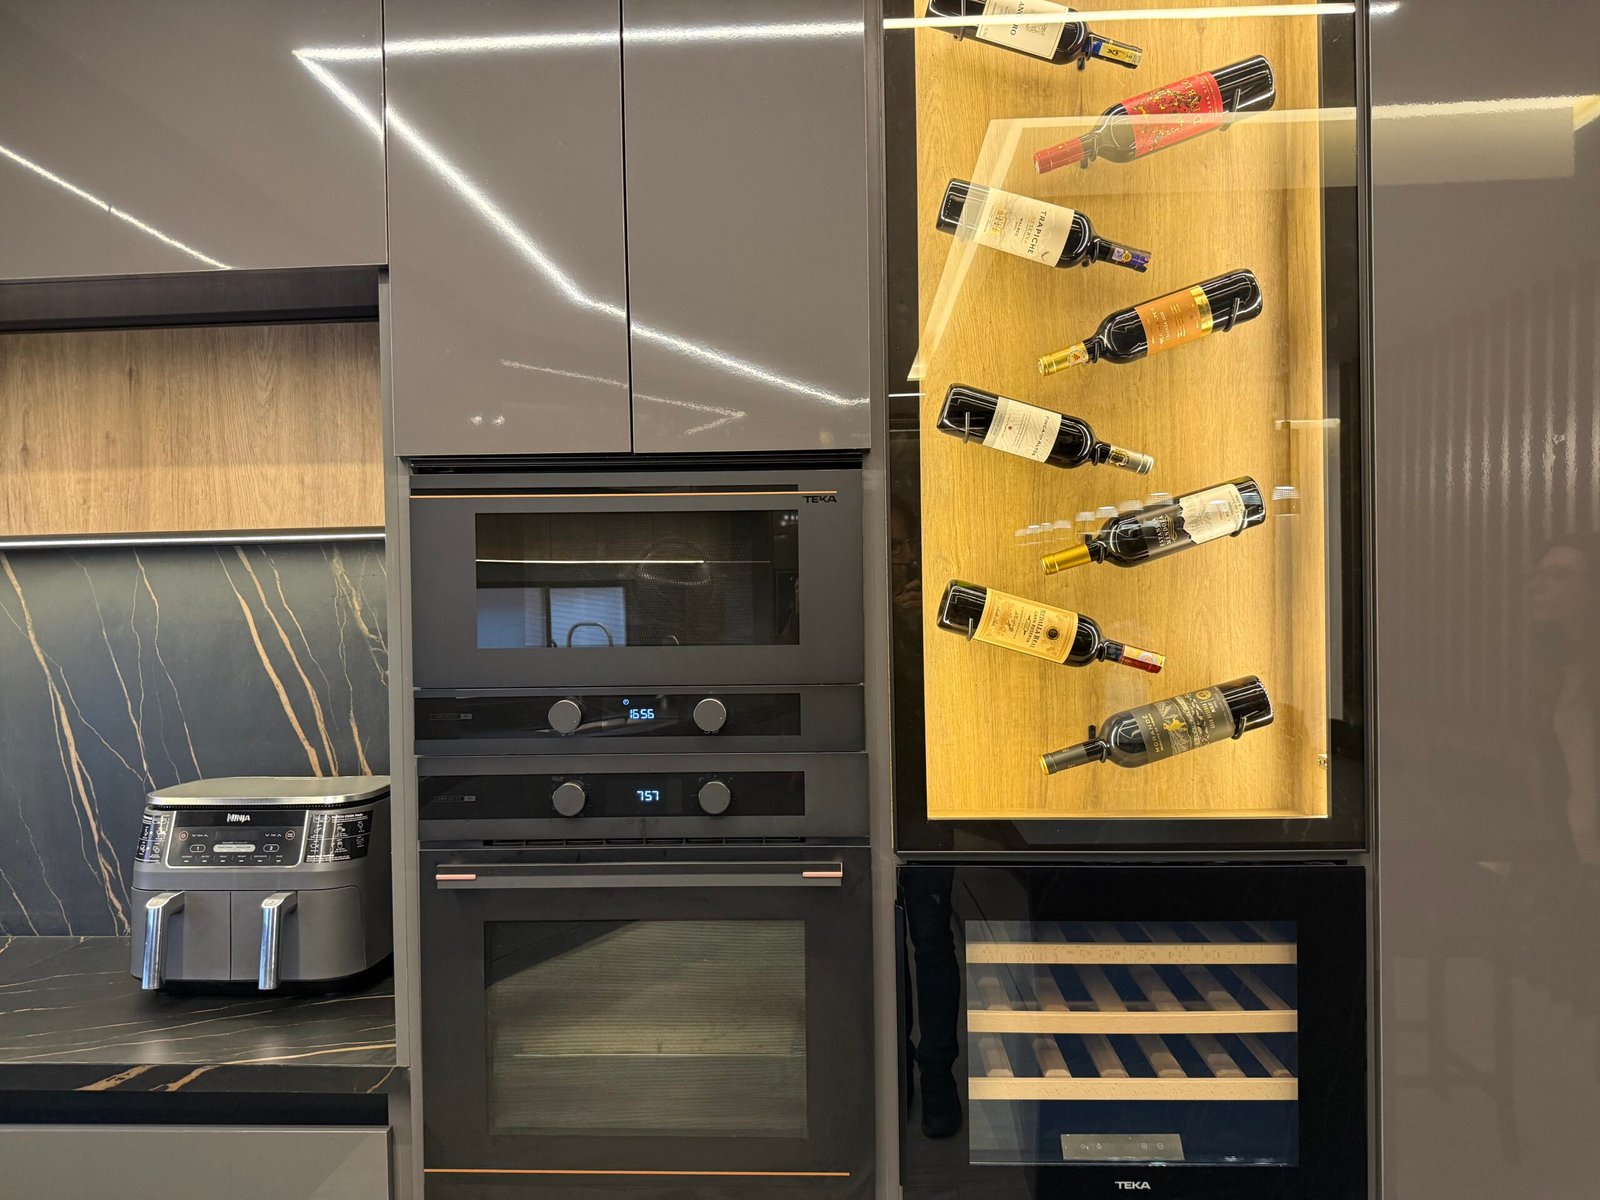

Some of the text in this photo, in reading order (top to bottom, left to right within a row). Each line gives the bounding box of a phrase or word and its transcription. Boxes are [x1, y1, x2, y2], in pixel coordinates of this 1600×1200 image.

[1180, 78, 1201, 125] DIABLO
[1026, 209, 1047, 254] TRAPICHE
[1040, 415, 1049, 433] FINCA
[802, 495, 837, 503] TEKA
[1158, 515, 1171, 545] MENDOZA
[636, 790, 660, 801] 757
[226, 813, 251, 823] NINJA
[1114, 1181, 1151, 1190] TEKA
